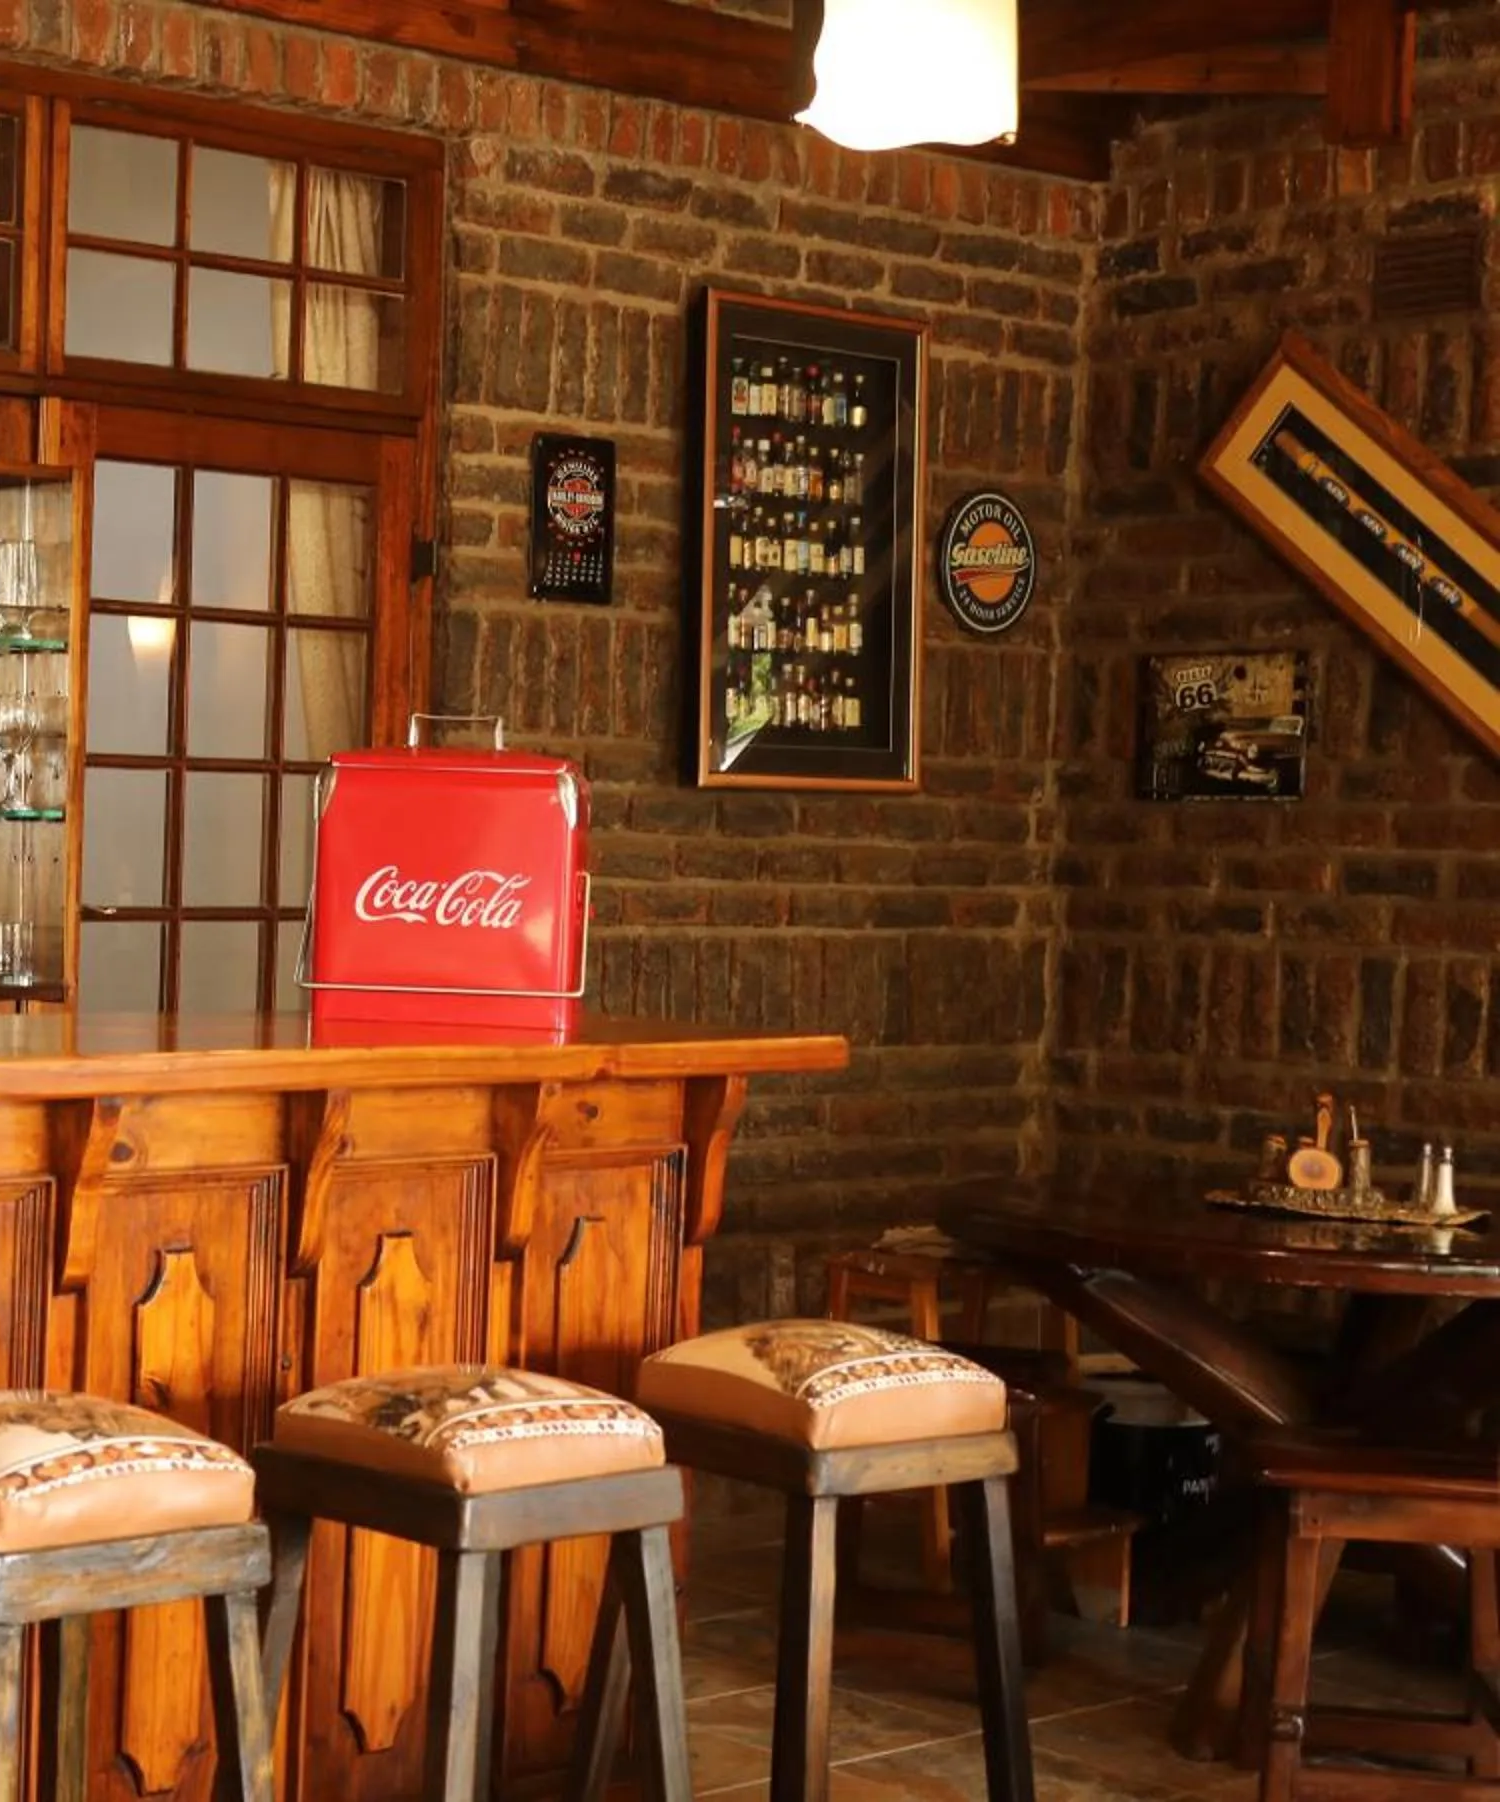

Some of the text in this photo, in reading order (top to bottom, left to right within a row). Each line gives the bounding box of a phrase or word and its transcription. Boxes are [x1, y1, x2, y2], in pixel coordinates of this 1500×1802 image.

[960, 503, 1022, 541] MOTOR OIL
[950, 542, 1029, 568] Gasoline
[1179, 683, 1213, 709] 66
